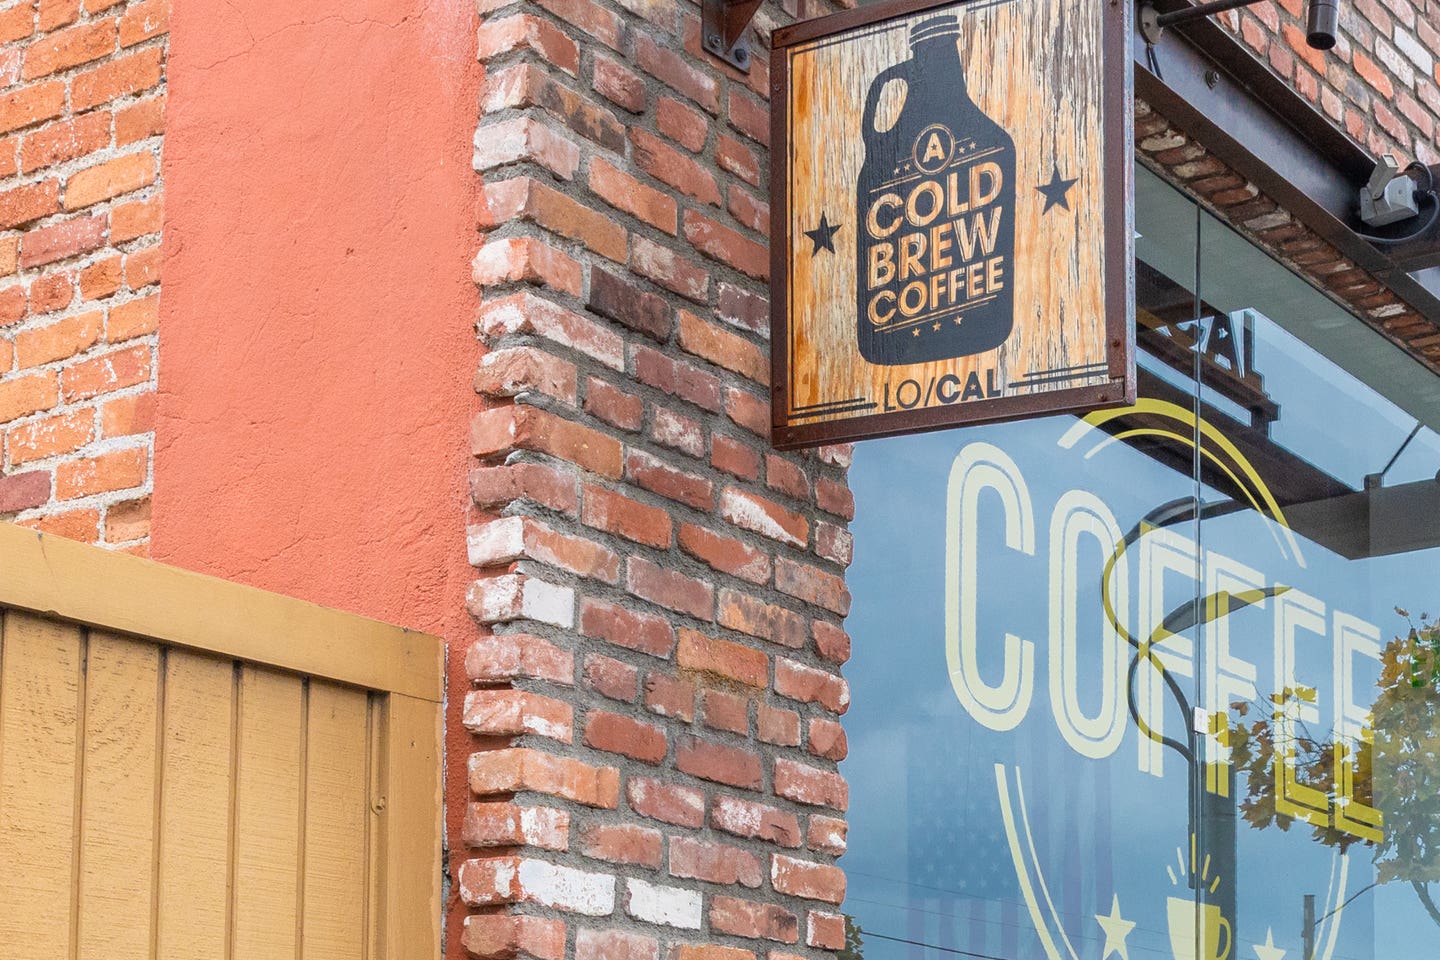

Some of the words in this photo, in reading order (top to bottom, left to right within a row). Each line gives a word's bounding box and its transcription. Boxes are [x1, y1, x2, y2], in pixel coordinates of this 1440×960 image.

[922, 132, 945, 163] A
[866, 161, 1003, 239] COLD
[867, 206, 1003, 291] BREW
[867, 256, 1004, 326] COFFEE
[884, 369, 1001, 413] LO/CAL
[945, 441, 1385, 845] COFFEE
